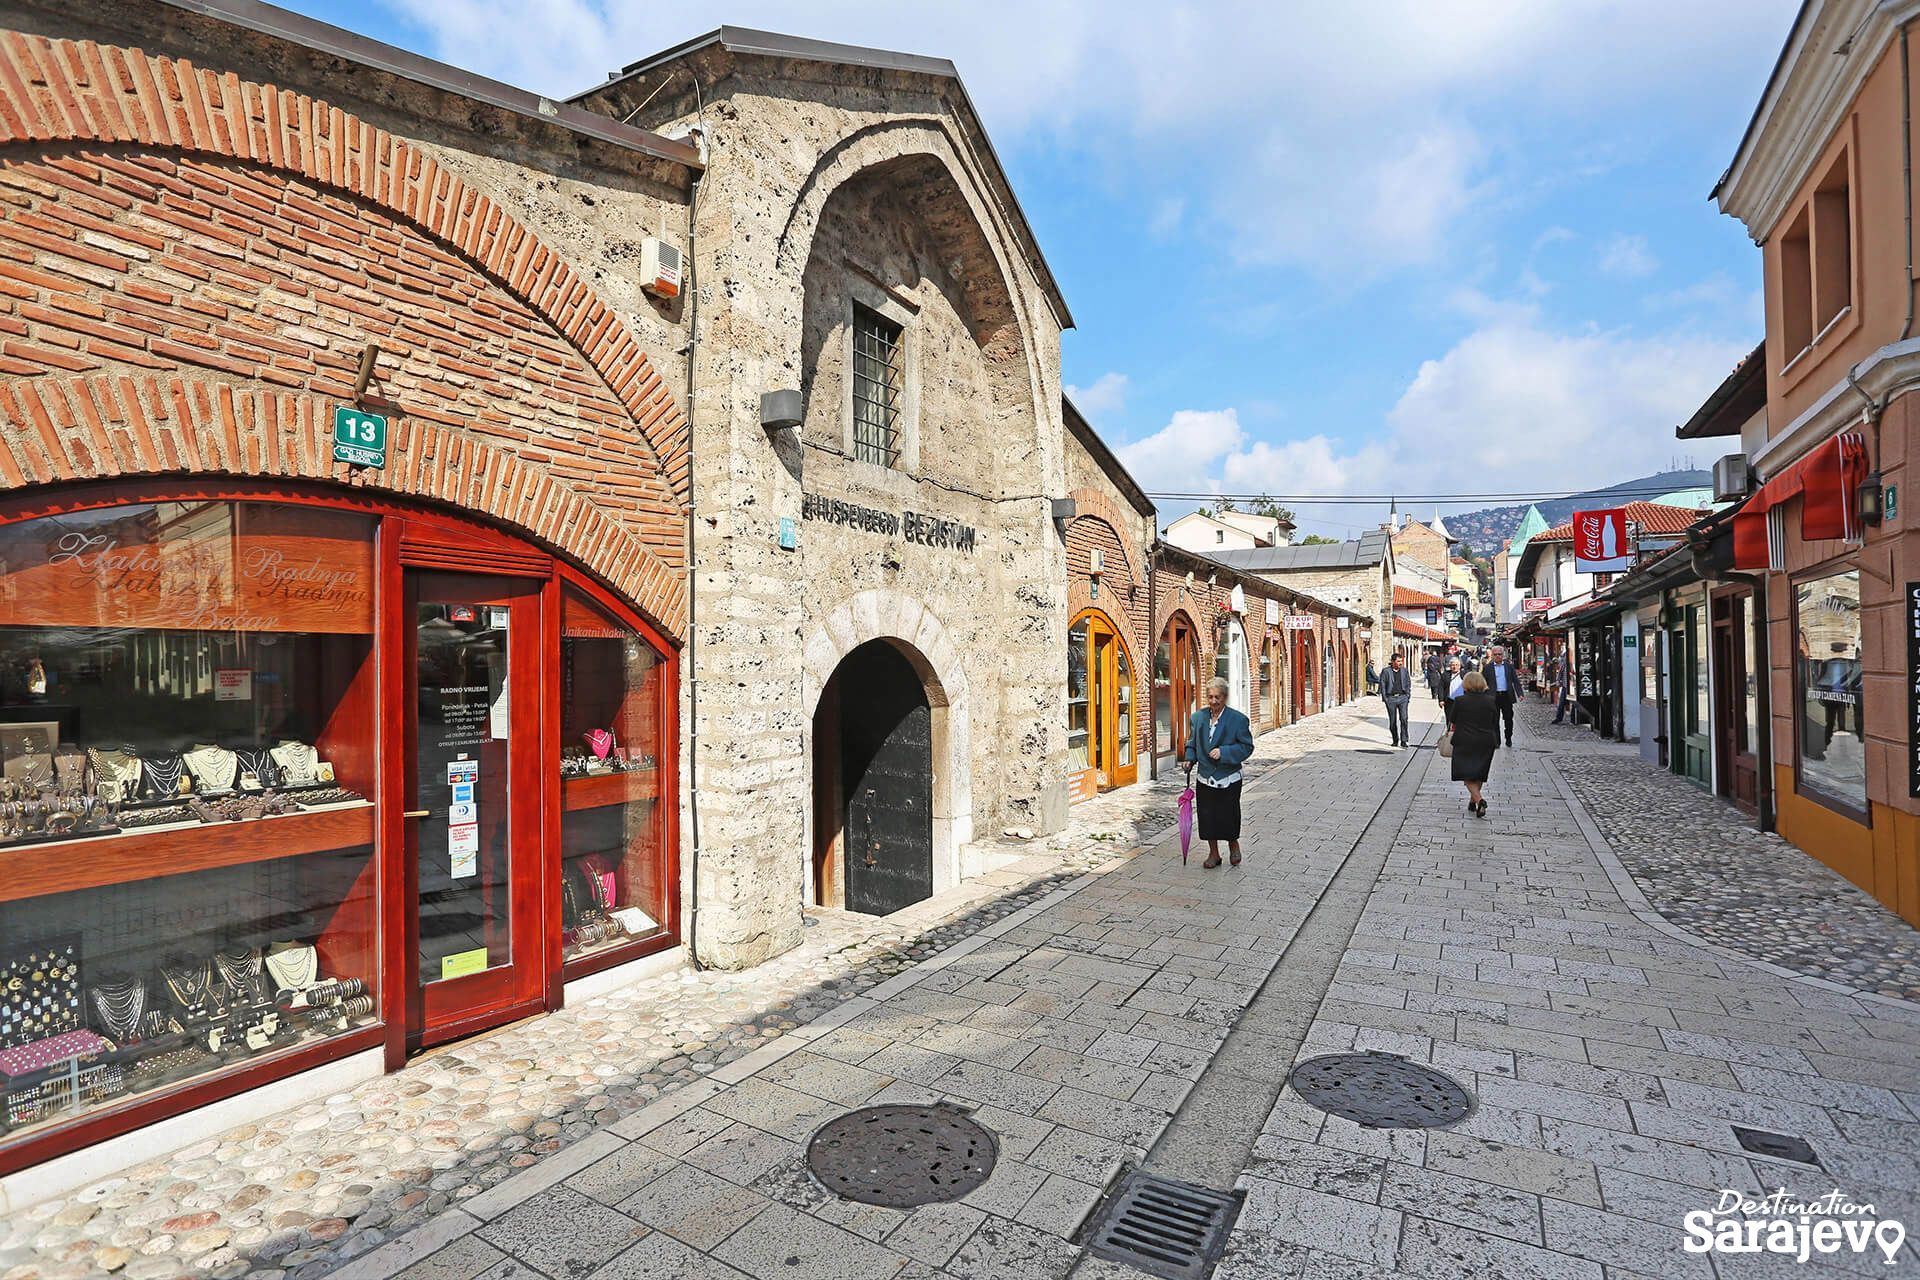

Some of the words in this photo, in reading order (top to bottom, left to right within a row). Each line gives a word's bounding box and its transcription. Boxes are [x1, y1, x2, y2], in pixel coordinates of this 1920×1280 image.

[345, 417, 376, 442] 13
[48, 532, 225, 576] Zlataa
[242, 546, 357, 593] Radnja
[561, 626, 600, 637] Unikatni
[602, 628, 625, 638] Nakit
